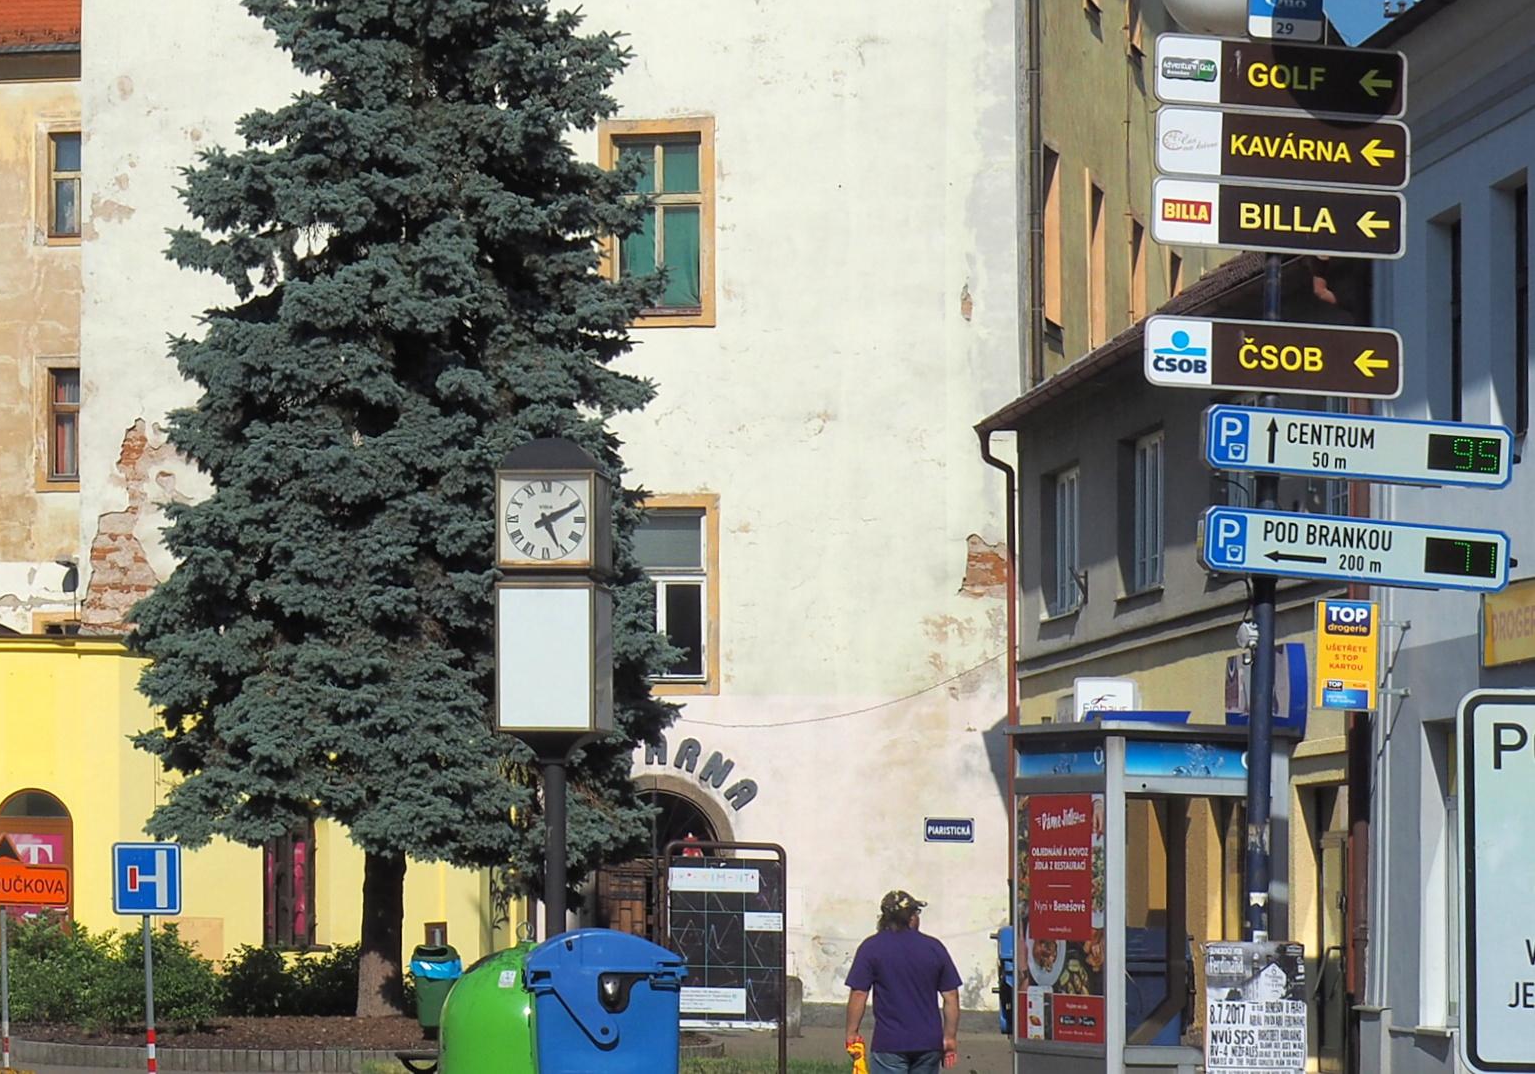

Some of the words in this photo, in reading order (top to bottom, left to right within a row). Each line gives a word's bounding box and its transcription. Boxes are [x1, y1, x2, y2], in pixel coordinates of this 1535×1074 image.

[1276, 22, 1294, 35] 29
[1248, 62, 1326, 91] GOLF
[1230, 132, 1352, 164] KAVÁRNA
[1164, 202, 1210, 222] BILLA
[1239, 202, 1337, 234] BILLA
[1153, 355, 1207, 374] ČSOB
[1239, 338, 1324, 372] ČSOB
[1287, 422, 1375, 450] CENTRUM
[1312, 451, 1329, 468] 50
[1334, 456, 1347, 470] m
[1453, 438, 1499, 473] 95
[1263, 520, 1299, 544] POD
[1306, 523, 1393, 552] BRANKOU
[1339, 554, 1364, 572] 200
[1369, 559, 1382, 573] m
[1454, 541, 1496, 575] 71
[1329, 606, 1368, 623] TOP
[1328, 623, 1368, 634] drogerie
[1326, 643, 1368, 653] UŠETŘETE
[1335, 653, 1340, 661] S
[1341, 654, 1359, 662] TOP
[1329, 662, 1364, 671] KARTOU
[1493, 722, 1535, 770] P
[927, 823, 971, 837] PIARISTICKÁ
[1069, 848, 1089, 857] DOVOZ
[1053, 899, 1086, 913] Benešově
[1210, 1004, 1246, 1025] 8.7.2017
[1211, 1028, 1232, 1044] NVÚ
[1234, 1030, 1255, 1045] SPS
